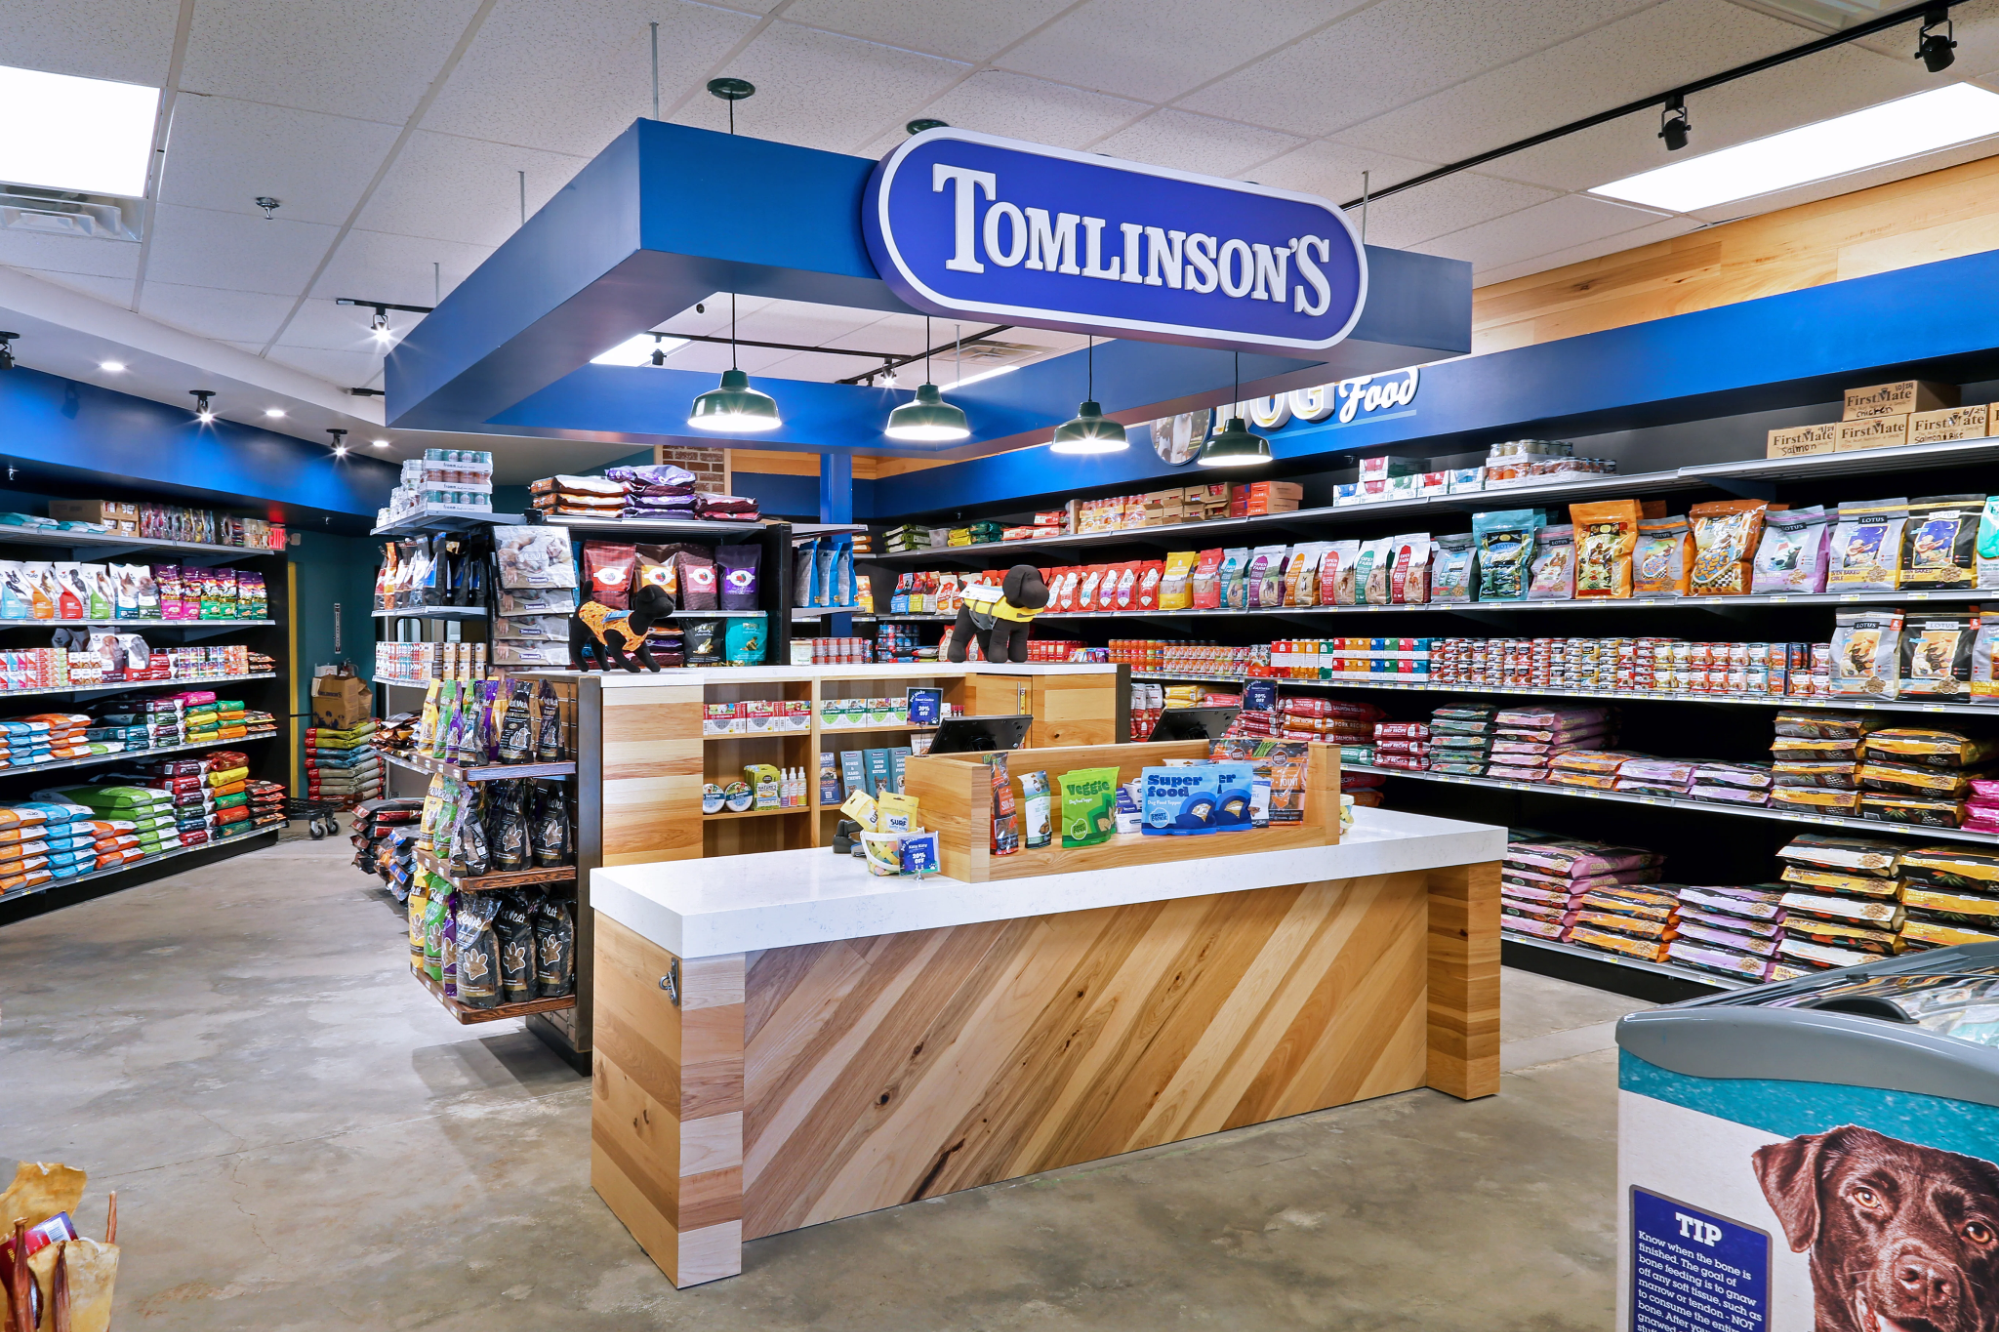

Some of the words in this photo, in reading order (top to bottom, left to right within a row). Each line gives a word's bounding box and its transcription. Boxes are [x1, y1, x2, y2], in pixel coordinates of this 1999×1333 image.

[932, 163, 1331, 317] TOMLINSON'S
[1339, 366, 1419, 424] Food
[1847, 388, 1912, 407] FirstMate
[1841, 421, 1905, 440] FirstMate
[1916, 411, 1985, 432] FirstMate
[1773, 431, 1833, 446] FirstMate
[1781, 443, 1817, 454] Salmon
[1066, 780, 1110, 796] Veggie
[1147, 774, 1203, 788] Super
[1147, 786, 1189, 797] food
[1675, 1211, 1723, 1247] TIP
[1638, 1230, 1666, 1247] Know
[1667, 1242, 1694, 1259] when
[1696, 1252, 1712, 1265] the
[1714, 1259, 1741, 1276] bone
[1742, 1270, 1752, 1280] is
[1638, 1242, 1679, 1265] finished.
[1681, 1258, 1699, 1272] The
[1700, 1267, 1724, 1282] goal
[1726, 1277, 1737, 1287] of
[1638, 1254, 1664, 1270] bone
[1665, 1264, 1702, 1287] feeding
[1704, 1280, 1713, 1290] is
[1714, 1283, 1725, 1294] to
[1725, 1290, 1757, 1307] gnaw
[1638, 1267, 1651, 1278] off
[1652, 1272, 1671, 1286] any
[1672, 1280, 1690, 1293] soft
[1691, 1286, 1722, 1307] tissue,
[1722, 1299, 1748, 1316] such
[1749, 1311, 1762, 1321] as
[1637, 1300, 1664, 1318] bone.
[1665, 1312, 1689, 1328] After
[1638, 1279, 1675, 1298] marrow
[1676, 1294, 1687, 1304] or
[1688, 1297, 1724, 1319] tendon
[1731, 1314, 1755, 1331] NOT
[1638, 1288, 1648, 1299] to
[1649, 1294, 1692, 1318] consume
[1693, 1312, 1710, 1325] the
[1711, 1319, 1741, 1332] entir
[1637, 1313, 1677, 1332] gnawed
